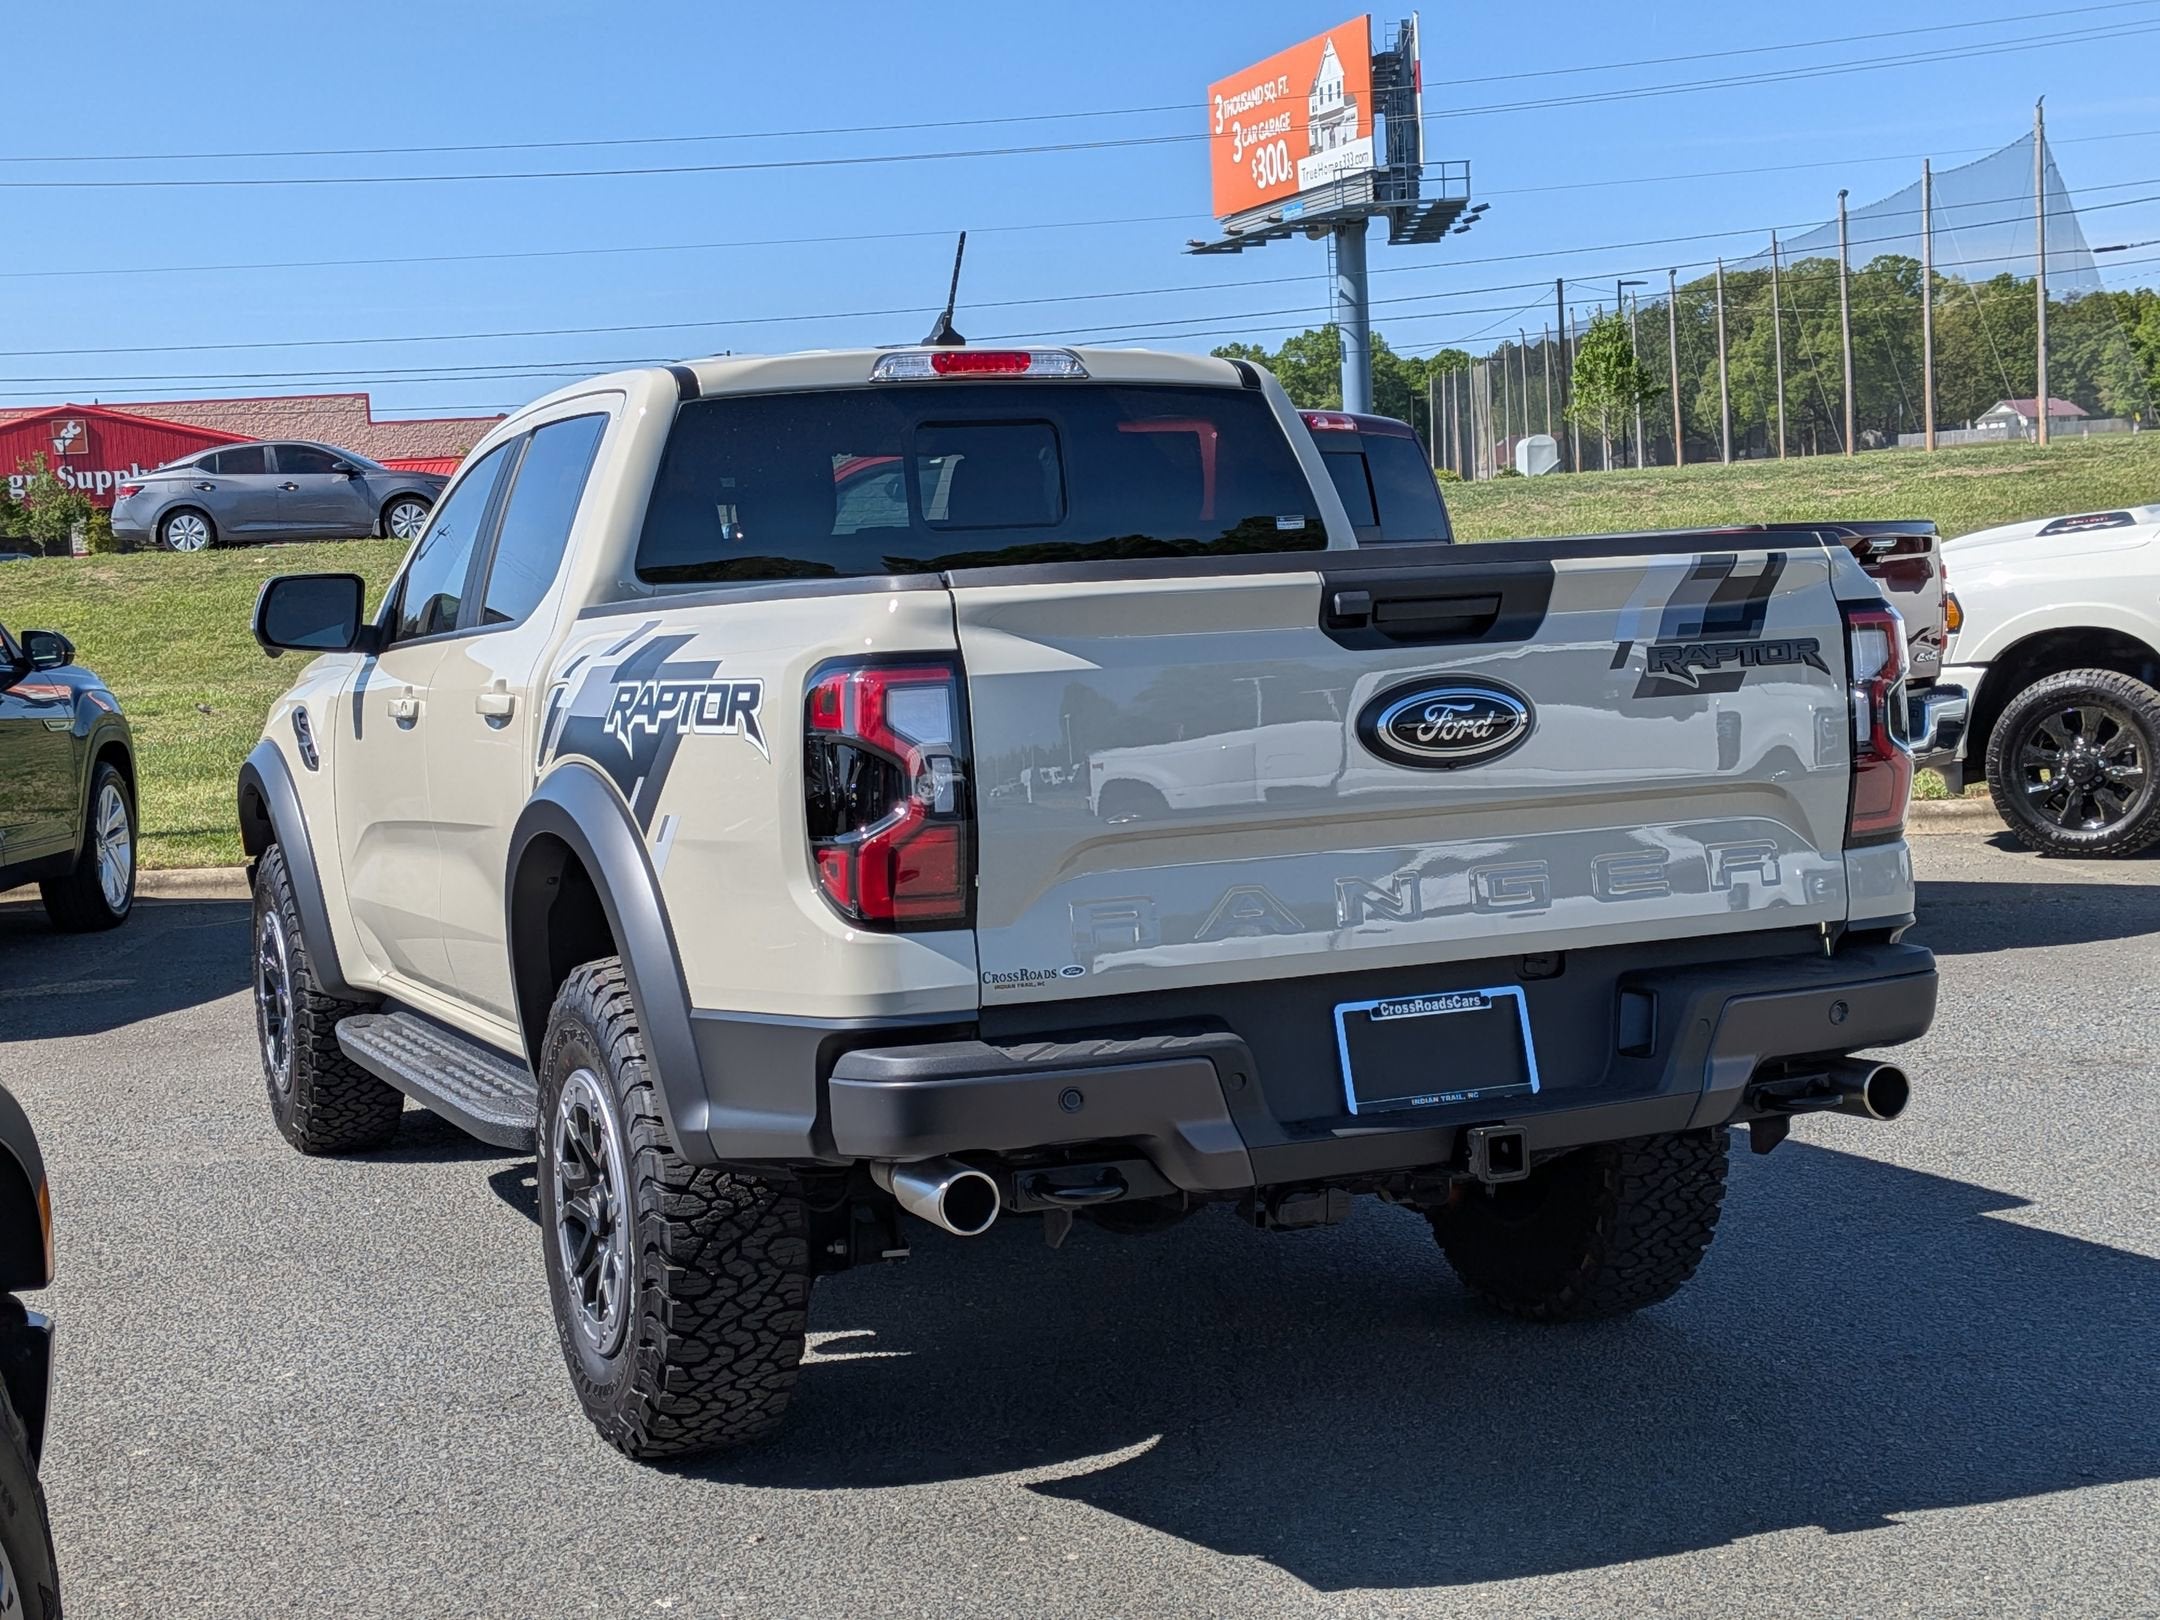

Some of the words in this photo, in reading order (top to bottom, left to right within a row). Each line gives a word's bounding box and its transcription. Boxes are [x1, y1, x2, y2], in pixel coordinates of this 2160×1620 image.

[1214, 94, 1224, 135] 3
[1223, 84, 1264, 120] THOUSAND
[1277, 75, 1289, 97] FT.
[1232, 121, 1243, 163] 3
[1242, 124, 1258, 147] CAR
[1258, 112, 1291, 142] GARAGE
[1646, 637, 1831, 688] RAPTOR
[603, 678, 772, 764] RAPTOR
[1416, 703, 1496, 742] Ford
[1069, 839, 1782, 950] RANGER
[1380, 995, 1481, 1016] CrossRoadsCars
[1411, 1096, 1439, 1106] INDIAN
[1467, 1091, 1479, 1099] NC
